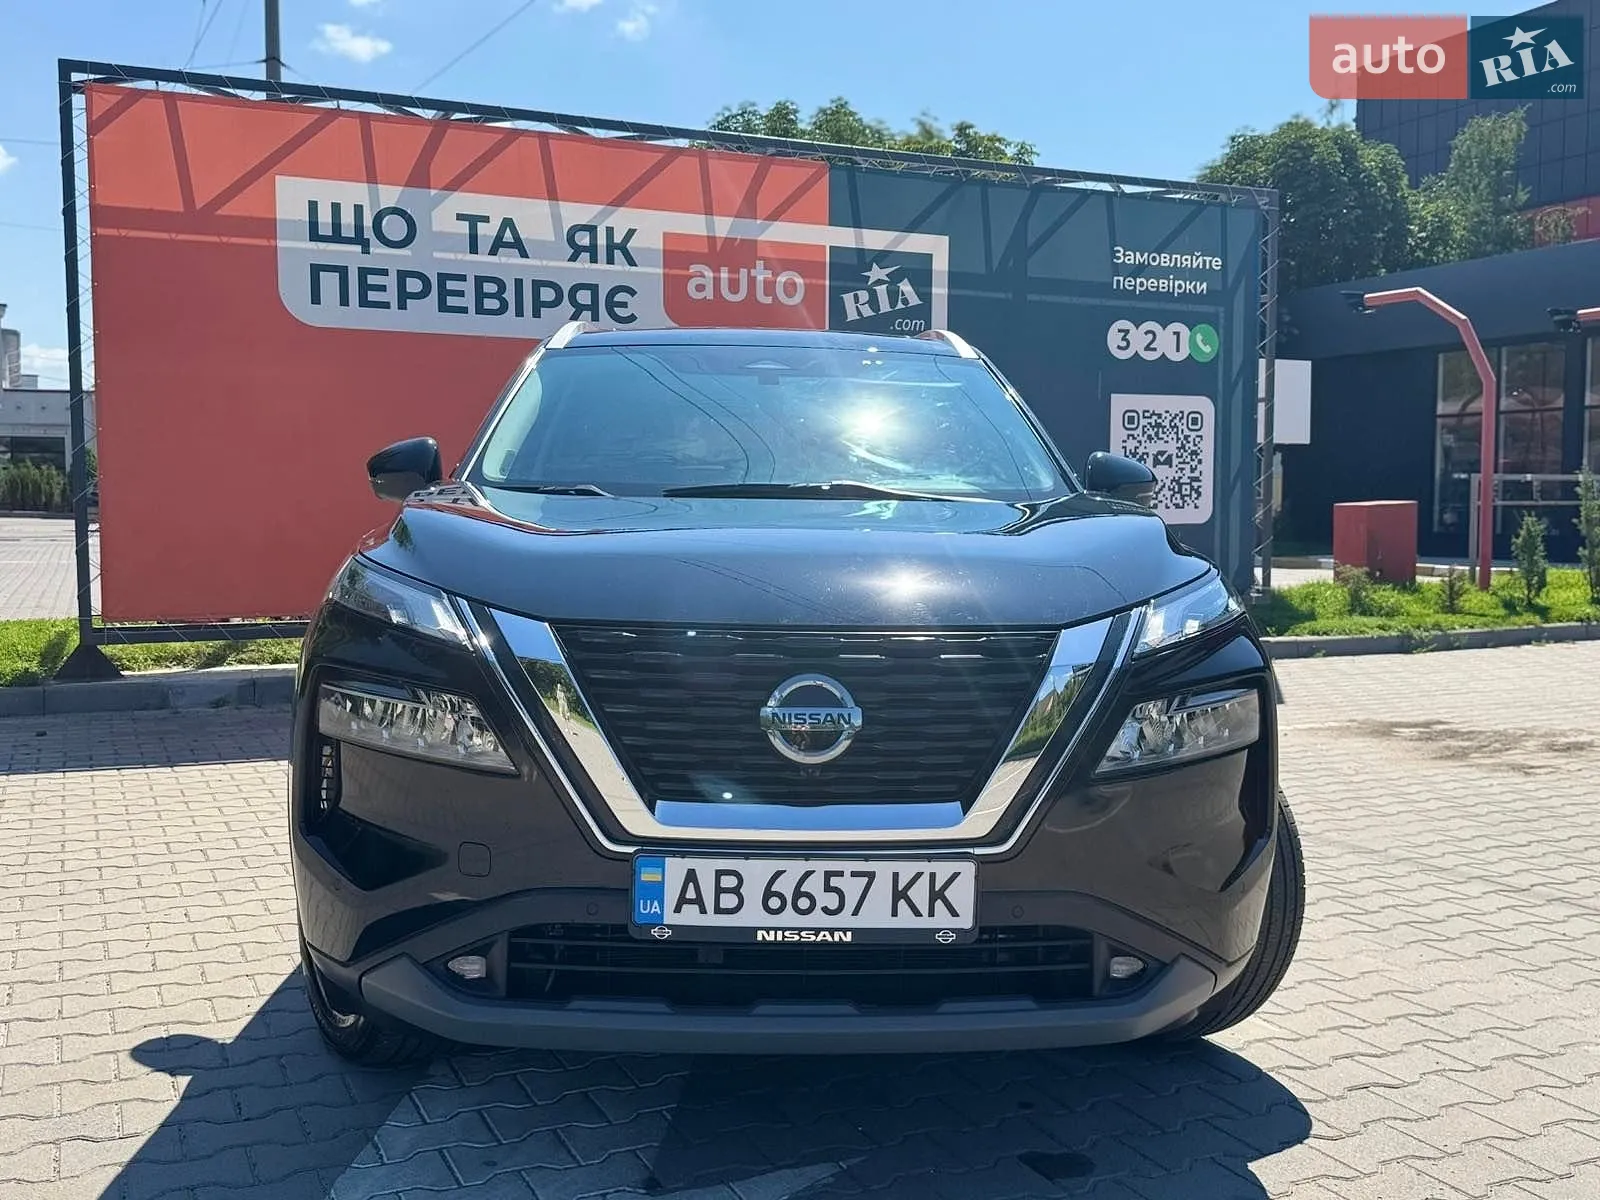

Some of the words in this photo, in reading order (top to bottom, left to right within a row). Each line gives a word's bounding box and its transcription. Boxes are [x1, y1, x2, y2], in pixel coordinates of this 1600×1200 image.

[308, 200, 417, 255] ЩО
[456, 213, 530, 259] ТА
[566, 223, 638, 267] ЯК
[1113, 246, 1222, 270] Замовляйте
[309, 263, 638, 324] ПЕРЕВІРЯЄ
[687, 260, 805, 305] auto
[840, 277, 924, 321] RIA
[1113, 274, 1207, 296] перевірки
[890, 317, 926, 331] .com
[771, 712, 852, 725] NISSAN
[673, 868, 745, 915] AB
[761, 869, 877, 917] 6657
[890, 871, 962, 918] KK
[640, 899, 661, 914] UA
[756, 929, 852, 942] NISSAN
